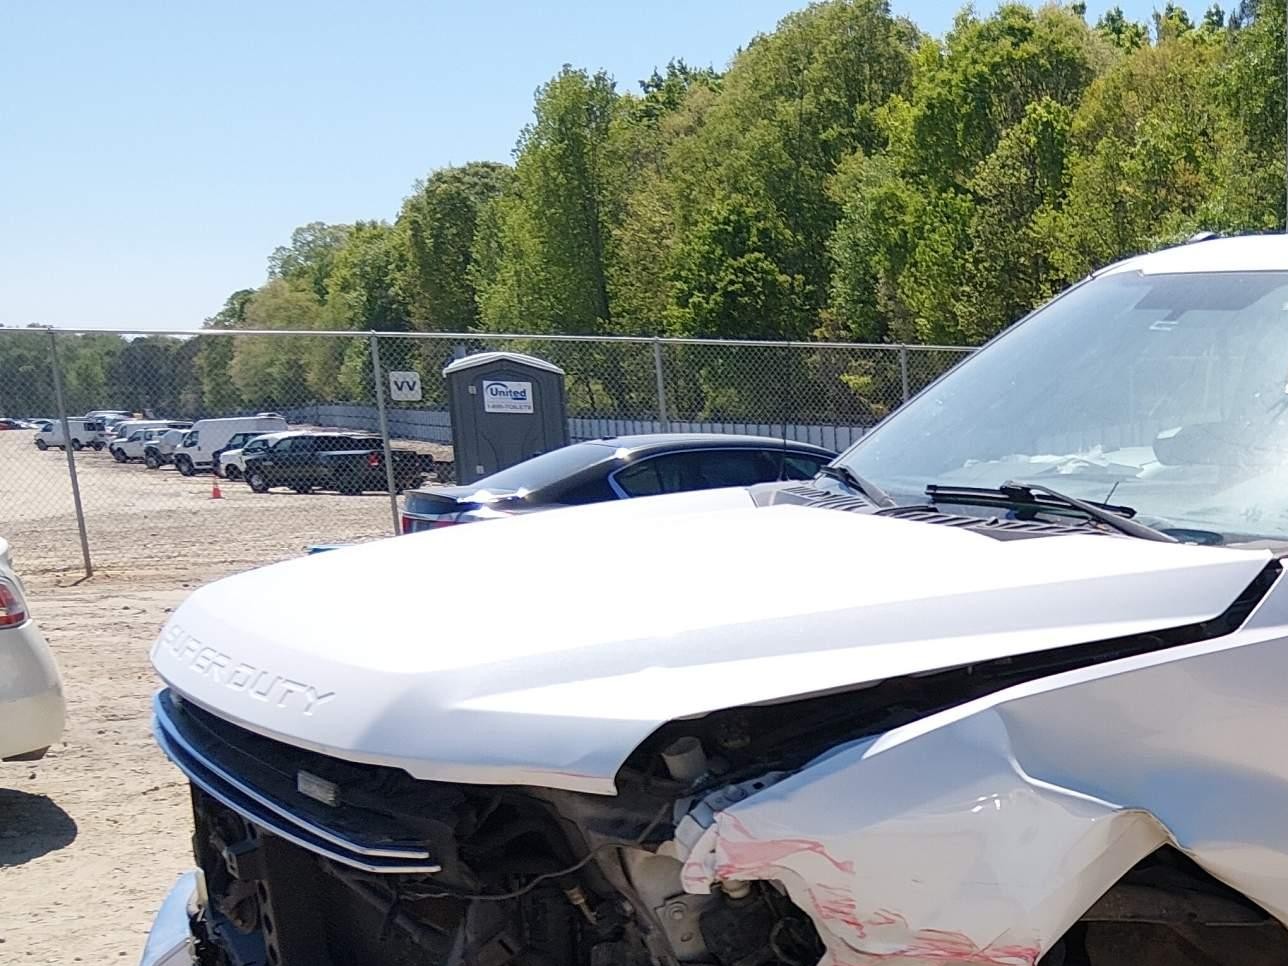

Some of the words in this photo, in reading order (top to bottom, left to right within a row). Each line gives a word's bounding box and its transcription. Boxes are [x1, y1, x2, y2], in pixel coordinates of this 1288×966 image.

[489, 388, 527, 398] United
[161, 624, 232, 683] SUPER
[225, 662, 336, 717] DUTY
